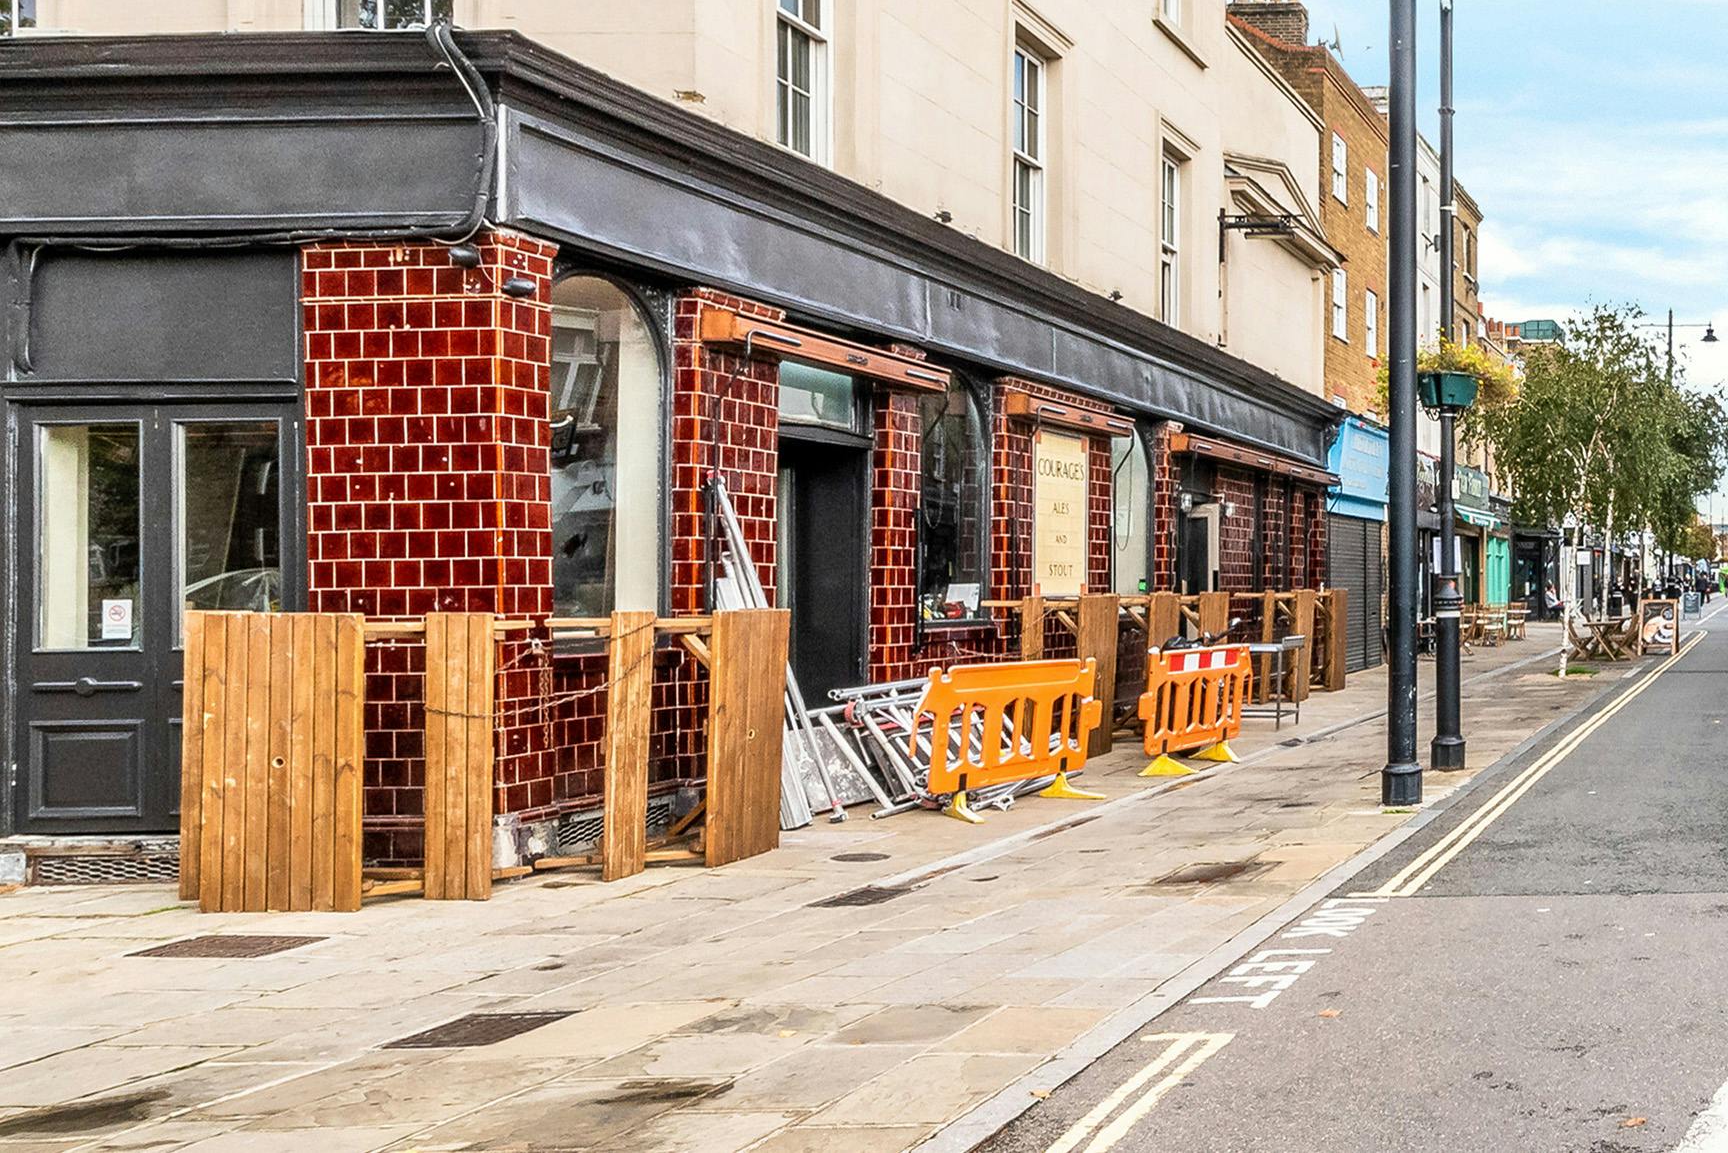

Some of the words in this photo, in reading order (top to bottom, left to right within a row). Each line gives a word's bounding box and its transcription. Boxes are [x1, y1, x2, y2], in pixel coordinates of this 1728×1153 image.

[1038, 458, 1085, 481] COURAGE'S
[1052, 502, 1070, 515] ALES
[1055, 535, 1068, 544] AND
[1048, 564, 1073, 577] STOUT
[1280, 896, 1390, 939] LOOK
[1186, 947, 1333, 1009] LEFT
